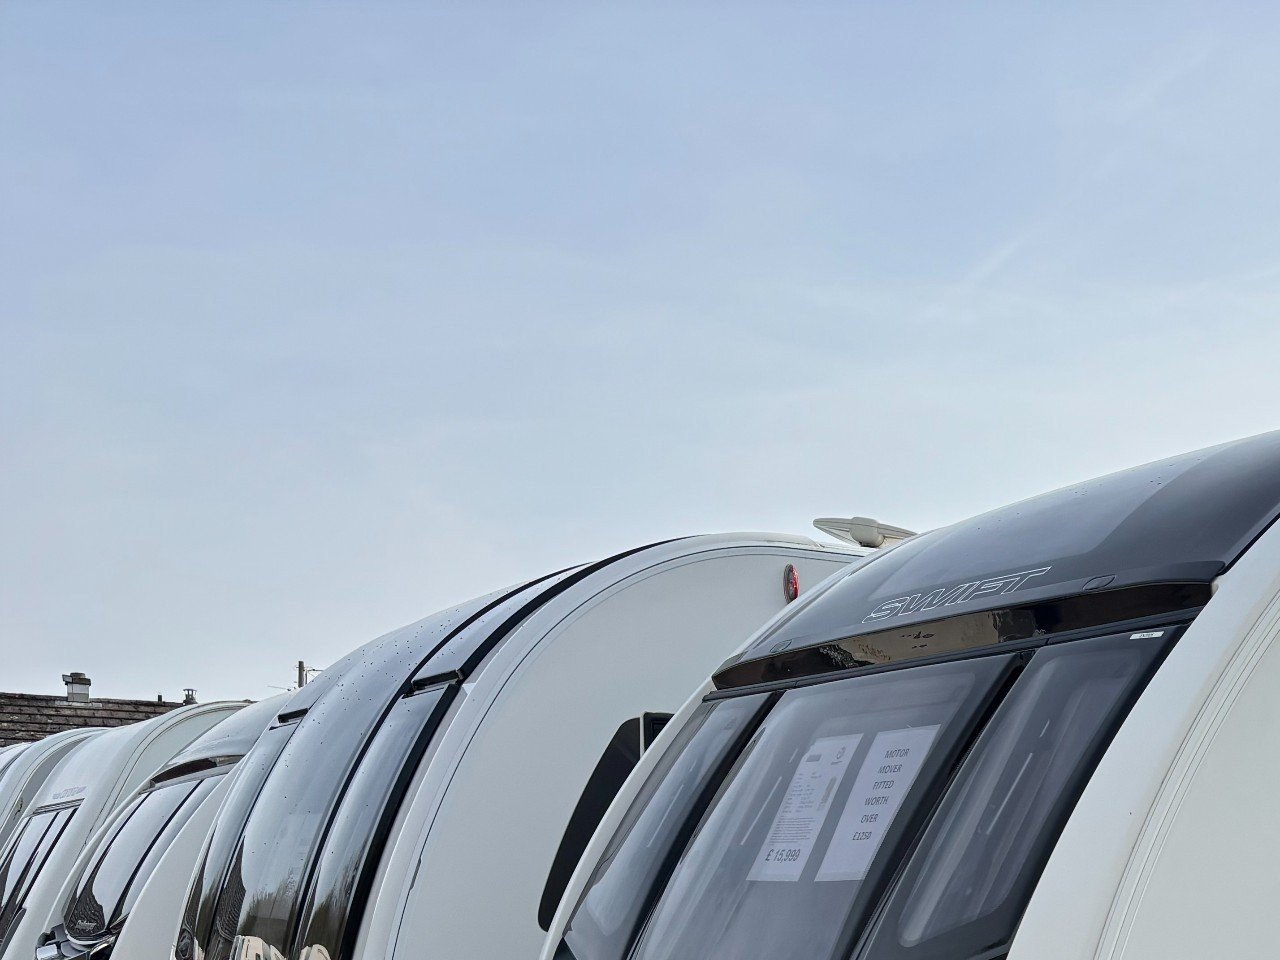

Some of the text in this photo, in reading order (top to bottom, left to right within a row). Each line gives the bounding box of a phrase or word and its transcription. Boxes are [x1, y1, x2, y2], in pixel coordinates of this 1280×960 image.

[862, 565, 1052, 624] SWIFT
[884, 748, 910, 758] MOTOR
[878, 764, 903, 774] MOVER
[872, 780, 895, 790] FITTED
[864, 796, 890, 806] WORTH
[860, 813, 879, 823] OVER
